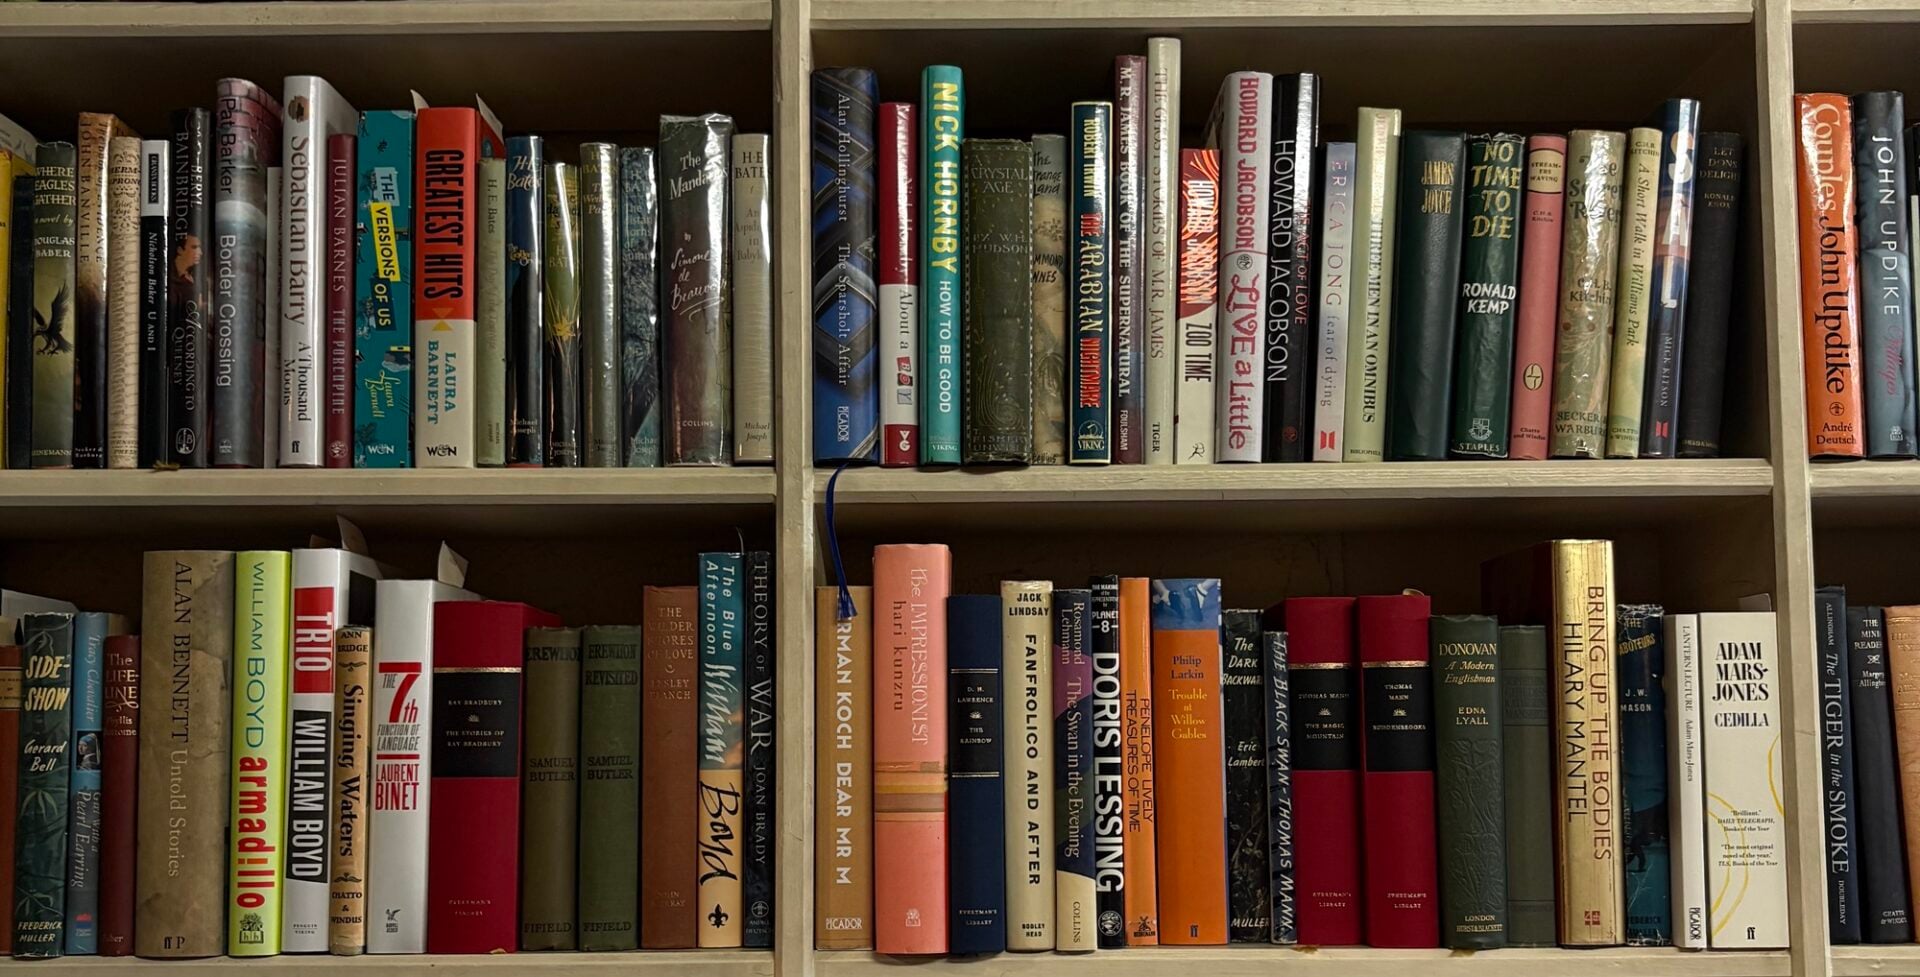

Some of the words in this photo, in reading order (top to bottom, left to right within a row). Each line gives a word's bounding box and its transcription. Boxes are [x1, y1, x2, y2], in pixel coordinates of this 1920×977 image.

[220, 98, 237, 130] Pat
[838, 93, 850, 126] Alan
[932, 83, 960, 152] NICK
[1120, 108, 1130, 154] JAMES
[1238, 78, 1259, 154] HOWARD
[80, 122, 90, 169] JOHN
[220, 133, 236, 194] Barker
[1482, 142, 1514, 162] NO
[1813, 104, 1844, 212] Couples
[176, 132, 189, 241] BAINBRIDGE
[333, 159, 347, 219] JULIAN
[381, 174, 396, 200] THE
[834, 130, 851, 222] Hollinghurst
[1421, 160, 1455, 186] JAMES
[1471, 165, 1524, 190] TIME
[1872, 136, 1895, 204] JOHN
[290, 136, 309, 253] Sebastian
[424, 150, 464, 246] GREATEST
[1236, 158, 1256, 249] JACOBSON
[1272, 140, 1295, 248] HOWARD
[1421, 189, 1452, 214] JOYCE
[1637, 182, 1650, 209] Short
[80, 176, 90, 262] BANVILLE
[488, 208, 498, 234] Bates
[932, 161, 958, 274] HORNBY
[1471, 216, 1514, 239] DIE
[1633, 212, 1648, 245] Walk
[148, 232, 157, 275] Nicholson
[333, 227, 346, 292] BARNES
[376, 207, 396, 278] VERSIONS
[1819, 225, 1847, 286] John
[220, 235, 236, 300] Border
[424, 254, 464, 298] HITS
[1079, 240, 1104, 333] ARABIAN
[1326, 244, 1344, 306] JONG
[1628, 264, 1644, 315] Williams
[1880, 220, 1900, 315] UPDIKE
[148, 278, 157, 304] Baker
[284, 260, 308, 325] Barry
[834, 276, 851, 339] Sparsholt
[900, 290, 913, 334] About
[940, 280, 952, 316] HOW
[1294, 285, 1309, 326] LOVE
[1462, 282, 1516, 300] RONALD
[1466, 300, 1510, 315] KEMP
[939, 320, 952, 340] TO
[1118, 275, 1130, 398] SUPERNATURAL
[1150, 308, 1165, 358] JAMES
[1186, 323, 1212, 347] ZOO
[1266, 257, 1291, 382] JACOBSON
[1627, 318, 1640, 346] Park
[1815, 290, 1852, 394] Updike
[216, 303, 236, 387] Crossing
[838, 344, 850, 386] Affair
[939, 344, 952, 364] BE
[284, 360, 296, 406] Moons
[298, 354, 312, 422] Thousand
[332, 340, 346, 416] PORCUPINE
[427, 340, 439, 424] BARNETT
[444, 352, 456, 412] LAURA
[939, 368, 952, 413] GOOD
[1185, 354, 1212, 382] TIME
[1362, 354, 1378, 423] OMNIBUS
[1660, 366, 1670, 408] KITSON
[837, 406, 850, 442] PICADOR
[1120, 409, 1128, 451] FOULSHAM
[1152, 422, 1161, 453] TIGER
[1228, 380, 1254, 450] Little
[1822, 422, 1853, 432] André
[1078, 440, 1104, 451] VIKING
[1459, 443, 1500, 452] STAPLES
[1816, 434, 1856, 445] Deutsch
[174, 560, 193, 624] ALAN
[722, 565, 735, 598] The
[1016, 592, 1042, 602] JACK
[251, 562, 264, 650] WILLIAM
[706, 560, 719, 656] Afternoon
[754, 561, 768, 648] THEORY
[893, 600, 906, 636] hari
[1009, 607, 1050, 616] LINDSAY
[1092, 610, 1120, 620] PLANET
[1588, 586, 1607, 662] BRING
[295, 612, 332, 672] TRIO
[341, 631, 362, 639] ANN
[722, 612, 735, 652] Blue
[1061, 608, 1074, 666] Lehmann
[1073, 602, 1086, 666] Rosamond
[1439, 642, 1497, 656] DONOVAN
[1716, 642, 1762, 660] ADAM
[756, 655, 765, 673] OF
[893, 646, 908, 712] kunzru
[910, 603, 928, 746] IMPRESSIONIST
[1170, 670, 1204, 680] Larkin
[1444, 673, 1496, 685] Englishman
[1460, 661, 1494, 670] Modern
[1562, 622, 1585, 711] HILARY
[1716, 662, 1768, 680] MARS-
[24, 686, 70, 712] SHOW
[170, 634, 191, 743] BENNETT
[246, 658, 266, 749] BOYD
[1025, 634, 1038, 759] FANFROLICO
[1092, 652, 1122, 751] DORIS
[1168, 688, 1208, 700] Trouble
[1274, 676, 1288, 732] BLACK
[1458, 706, 1486, 714] EDNA
[1621, 704, 1652, 712] MASON
[1712, 683, 1769, 702] JONES
[337, 684, 364, 769] Singing
[750, 678, 773, 756] WAR
[836, 692, 852, 750] KOCH
[1170, 714, 1206, 725] Willow
[1170, 728, 1206, 740] Gables
[1456, 716, 1489, 725] LYALL
[1591, 712, 1609, 761] THE
[1714, 712, 1769, 727] CEDILLA
[1824, 678, 1844, 751] TIGER
[24, 738, 68, 754] Gerard
[30, 756, 57, 772] Bell
[292, 718, 326, 812] WILLIAM
[376, 736, 420, 752] LANGUAGE
[529, 758, 576, 768] SAMUEL
[587, 756, 633, 766] SAMUEL
[170, 750, 188, 810] Untold
[376, 764, 420, 782] LAURENT
[530, 772, 576, 782] BUTLER
[753, 764, 766, 806] JOAN
[836, 762, 852, 817] DEAR
[1027, 770, 1039, 810] AND
[1566, 722, 1588, 823] MANTEL
[340, 776, 360, 857] Waters
[375, 782, 419, 810] BINET
[1142, 780, 1153, 822] LIVELY
[1592, 772, 1612, 860] BODIES
[168, 816, 186, 878] Stories
[236, 756, 276, 908] armadillo
[755, 812, 766, 864] BRADY
[836, 827, 852, 858] MR
[1064, 798, 1084, 858] Evening
[1094, 756, 1125, 893] LESSING
[1828, 790, 1850, 874] SMOKE
[292, 819, 324, 877] BOYD
[1028, 820, 1040, 884] AFTER
[826, 918, 863, 930] PICADOR
[1073, 900, 1081, 943] COLLINS
[1838, 880, 1847, 925] DOUBLEDAY
[18, 920, 63, 931] FREDERICK
[20, 933, 56, 942] MULLER
[524, 922, 572, 933] FIFIELD
